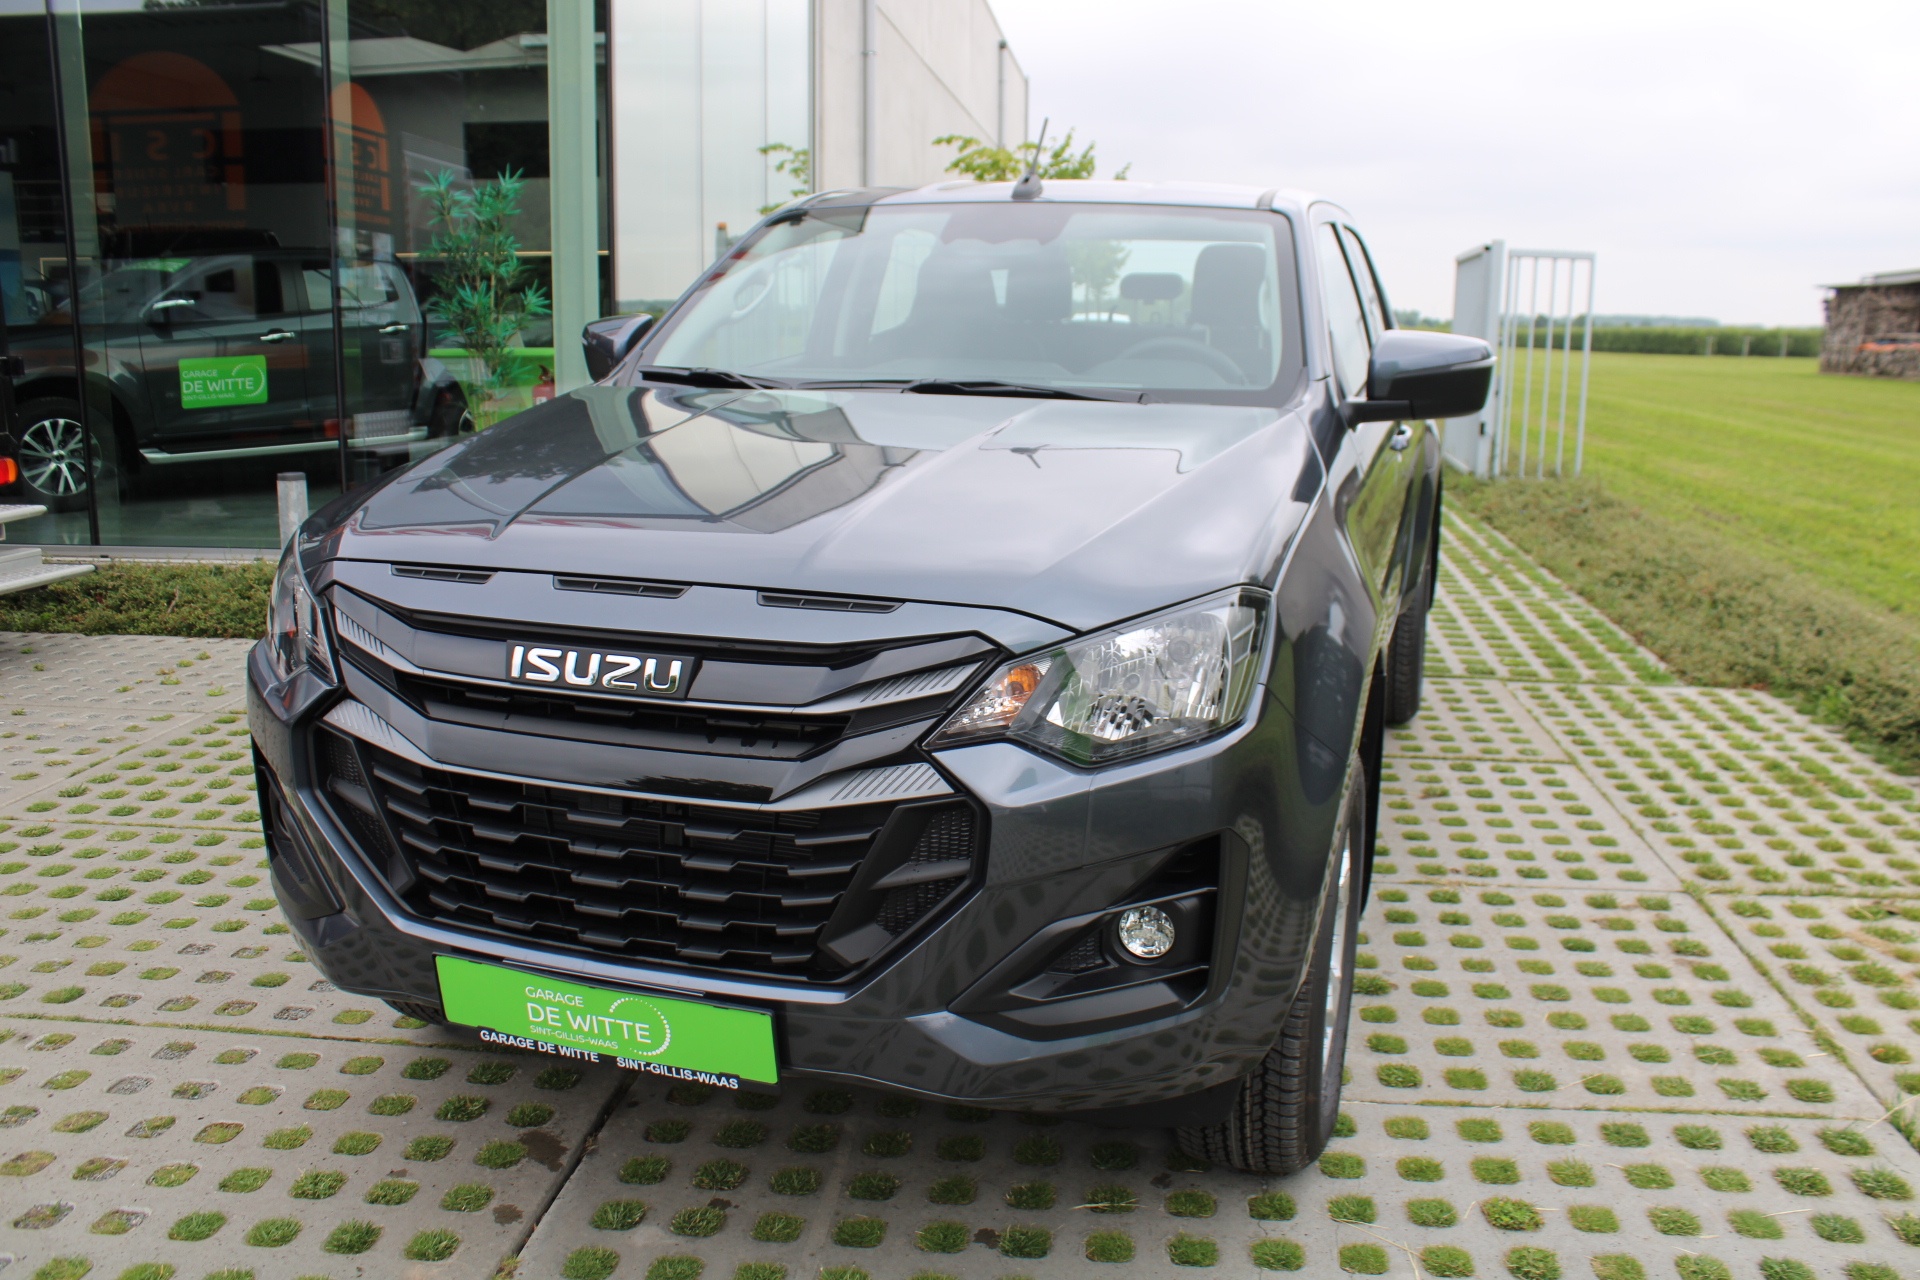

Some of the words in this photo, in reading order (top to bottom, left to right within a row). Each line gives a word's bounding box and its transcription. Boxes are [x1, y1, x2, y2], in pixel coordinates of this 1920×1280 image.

[182, 369, 218, 378] GARAGE
[183, 380, 203, 394] DE
[207, 377, 254, 392] WITTE
[510, 645, 682, 694] ISUZU
[525, 985, 584, 1008] GARAGE
[526, 1002, 562, 1027] DE
[567, 1010, 652, 1044] WITTE
[529, 1025, 619, 1050] SINT-GILLIS-WAAS
[480, 1029, 536, 1051] GARAGE
[538, 1041, 556, 1055] DE
[558, 1044, 600, 1063] WITTE
[616, 1056, 739, 1090] SINT-GILLIS-WAAS
